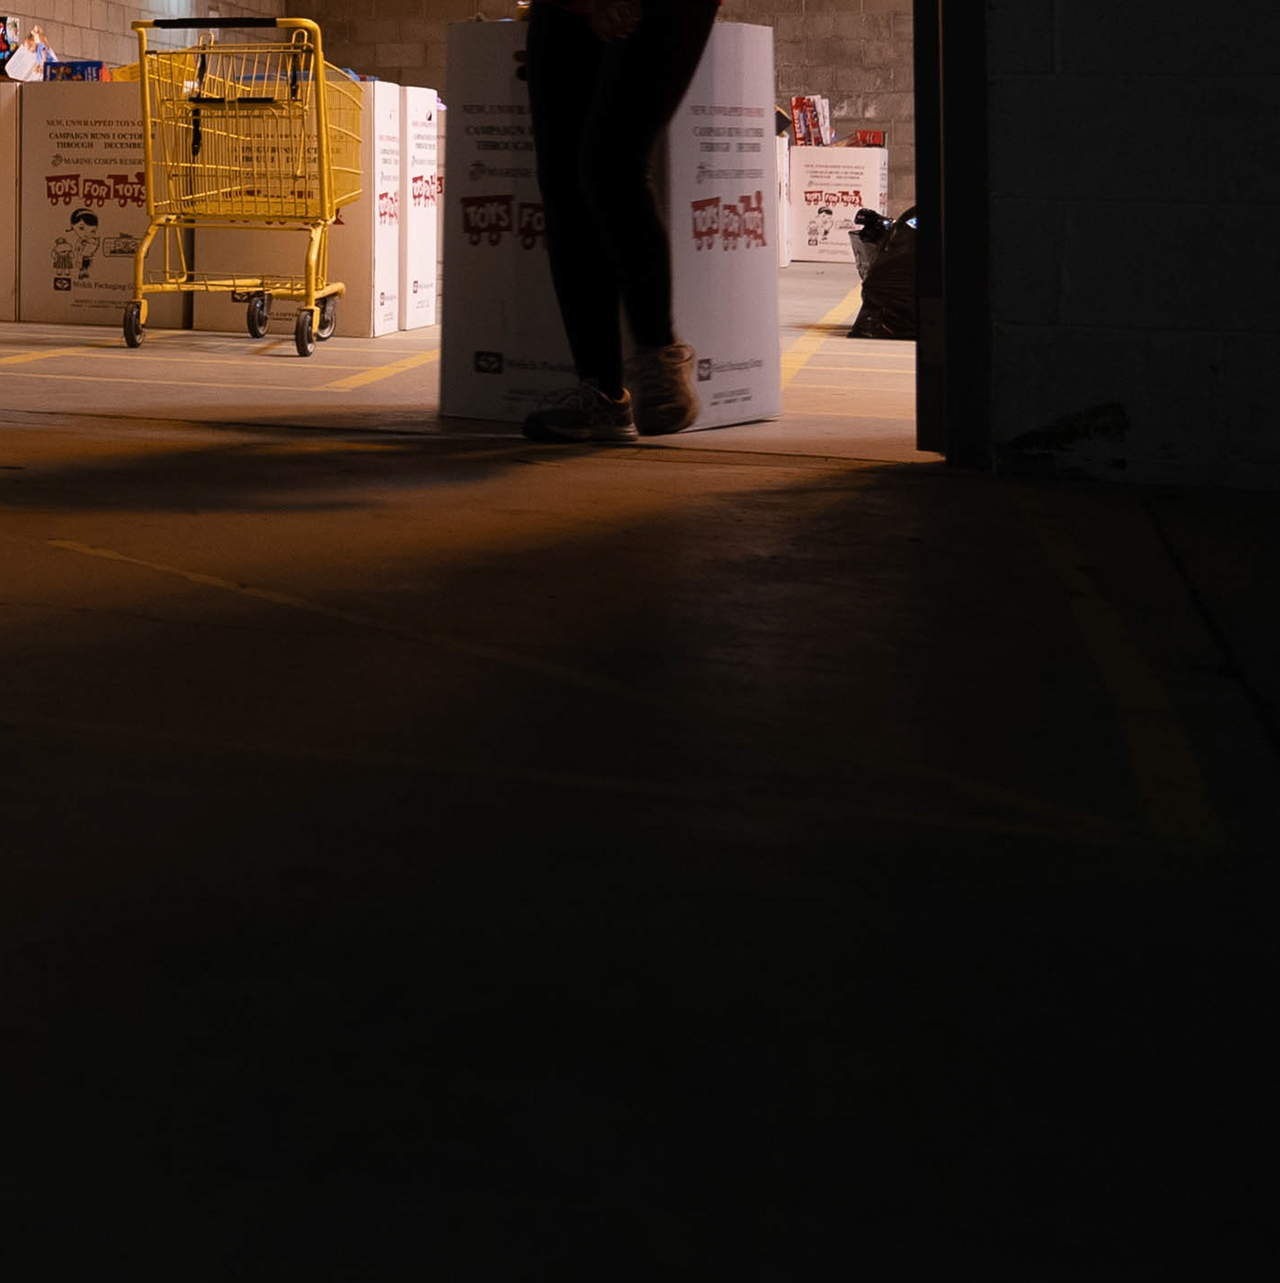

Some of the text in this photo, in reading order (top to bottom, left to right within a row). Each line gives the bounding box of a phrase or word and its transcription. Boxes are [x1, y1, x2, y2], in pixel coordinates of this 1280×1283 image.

[48, 178, 77, 195] TOYS
[84, 183, 107, 197] FOR
[522, 209, 545, 231] FO
